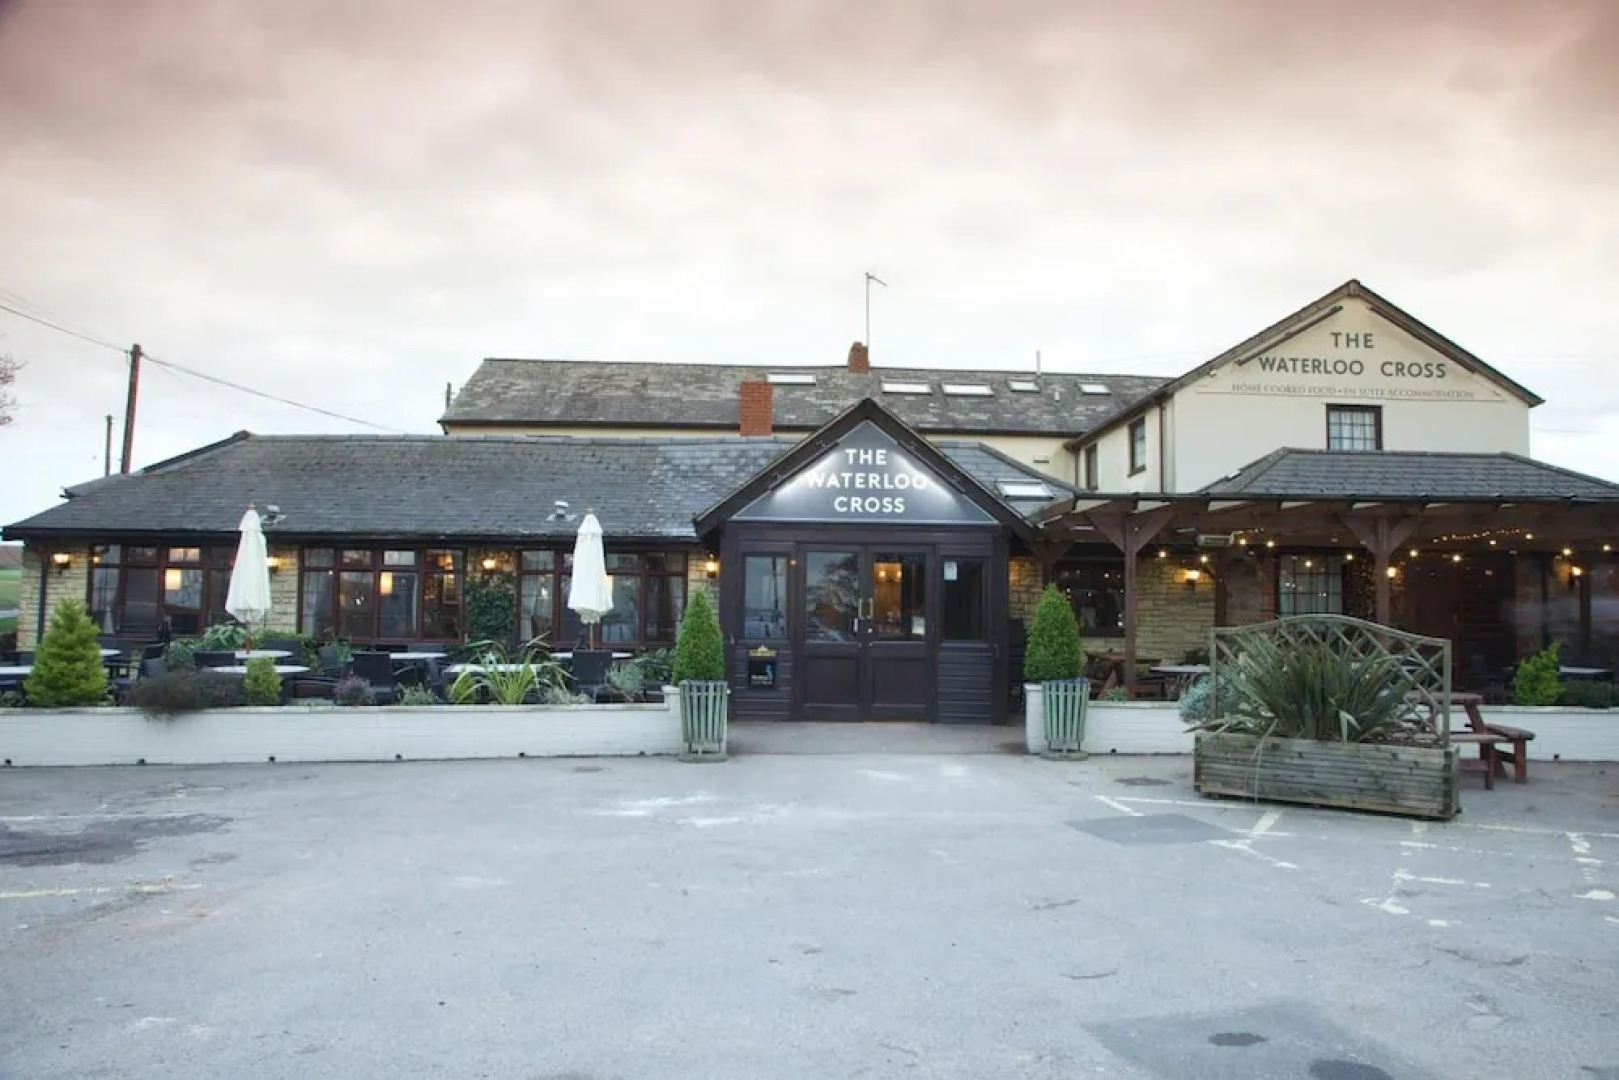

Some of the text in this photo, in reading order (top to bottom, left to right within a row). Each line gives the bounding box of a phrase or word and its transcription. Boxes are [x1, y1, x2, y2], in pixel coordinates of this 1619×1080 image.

[1331, 332, 1374, 349] THE
[1259, 357, 1447, 379] WATERLOO CROSS
[845, 449, 887, 466] THE
[806, 473, 928, 490] WATERLOO
[834, 496, 905, 513] CROSS
